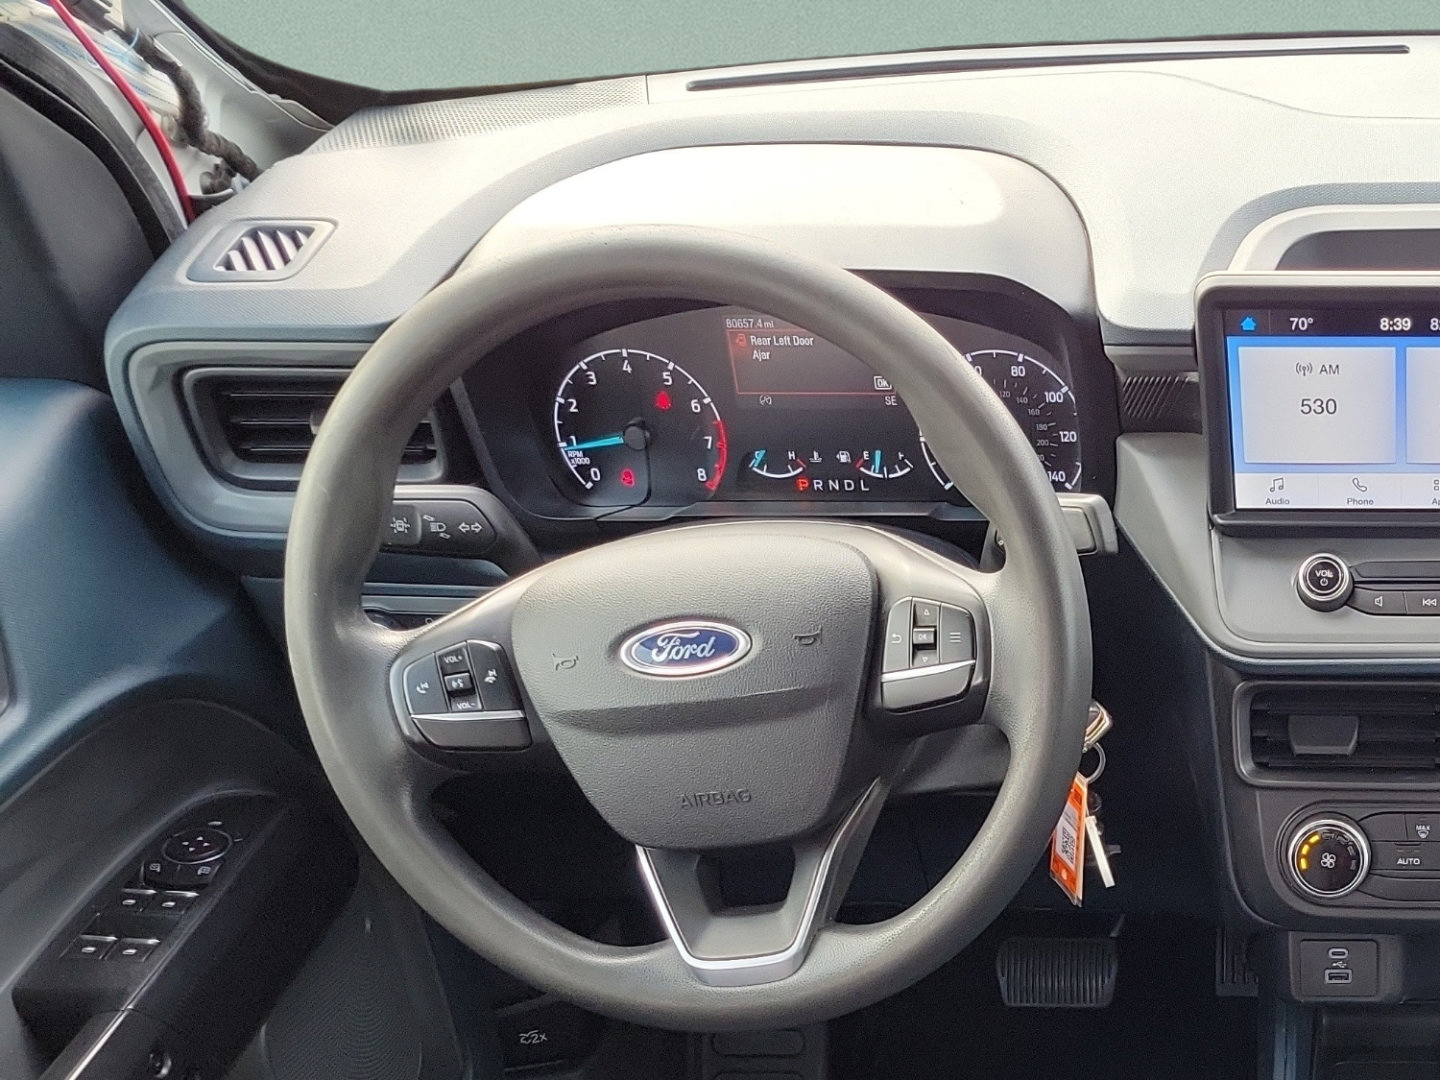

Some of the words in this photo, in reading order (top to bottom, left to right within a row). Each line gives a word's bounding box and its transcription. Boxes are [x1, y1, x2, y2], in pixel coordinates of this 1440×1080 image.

[726, 318, 763, 328] 80657.4
[1289, 317, 1314, 331] 70°
[1379, 317, 1411, 331] 8:39
[750, 335, 772, 346] Rear
[773, 335, 791, 346] Left
[793, 335, 814, 346] Door
[752, 350, 770, 362] Ajar
[622, 360, 632, 374] 4
[1010, 365, 1026, 377] 80
[1319, 363, 1340, 376] AM
[586, 371, 597, 385] 3
[662, 371, 673, 385] 5
[876, 378, 888, 388] OK
[1044, 391, 1063, 403] 100
[567, 399, 578, 413] 2
[691, 399, 701, 413] 6
[1299, 397, 1338, 416] 530
[703, 436, 713, 449] 7
[1059, 431, 1077, 442] 120
[567, 450, 583, 458] RPM
[788, 451, 796, 460] H
[863, 451, 870, 460] E
[590, 468, 601, 481] 0
[697, 468, 707, 482] 8
[1047, 470, 1066, 482] 140
[796, 479, 809, 492] P
[813, 479, 824, 491] R
[828, 479, 840, 491] N
[844, 479, 855, 491] D
[860, 479, 870, 491] L
[1265, 497, 1290, 506] Audio
[1346, 497, 1374, 506] Phone
[650, 631, 716, 662] Ford
[681, 789, 752, 808] AIRBAG
[1396, 857, 1421, 866] AUTO
